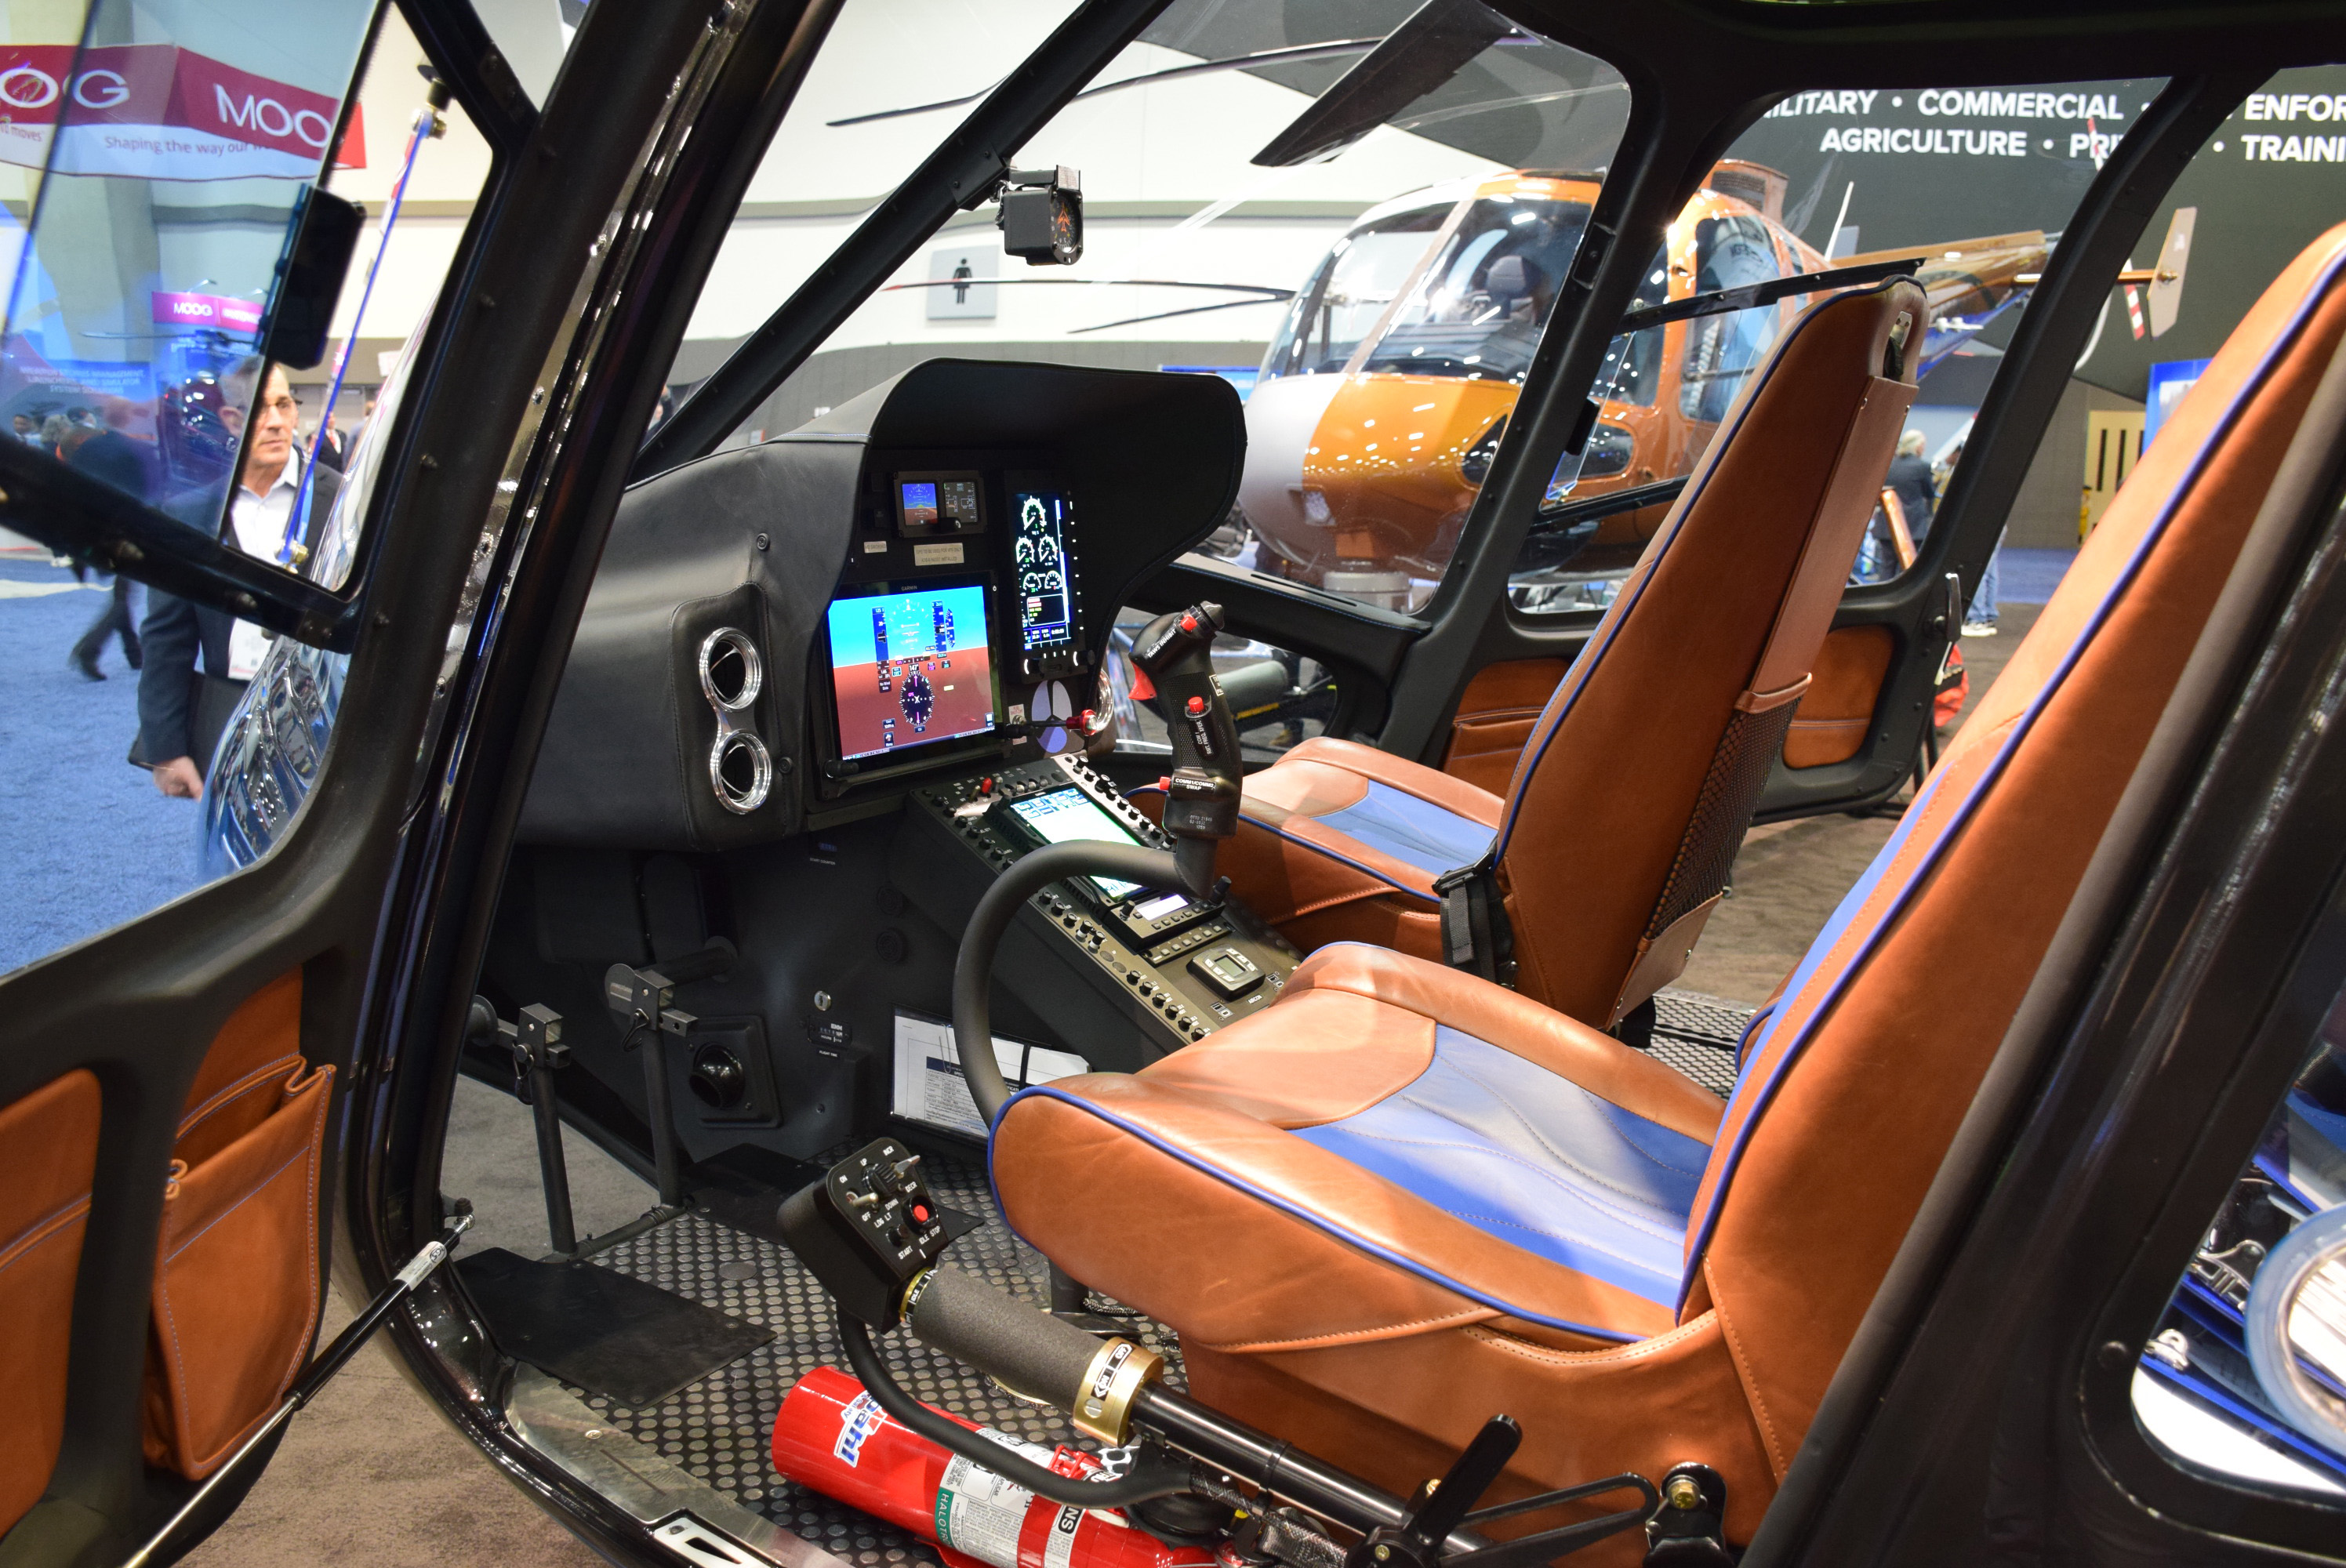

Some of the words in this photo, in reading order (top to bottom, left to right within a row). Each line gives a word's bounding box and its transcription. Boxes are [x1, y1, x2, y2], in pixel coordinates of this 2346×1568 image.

[0, 68, 129, 108] OG
[1917, 89, 2124, 119] COMMERCIAL
[2244, 94, 2346, 121] ENFOR
[213, 82, 332, 147] MOO
[104, 136, 162, 154] Shaping
[166, 139, 192, 153] the
[196, 143, 225, 157] way
[1819, 128, 2028, 157] AGRICULTURE
[2240, 134, 2346, 162] TRAINI
[173, 302, 213, 317] MOOG
[1147, 641, 1161, 658] TAWS
[1159, 629, 1177, 648] INHIBIT
[883, 1145, 894, 1156] INCR
[860, 1158, 867, 1167] UP
[839, 1174, 848, 1183] ON
[905, 1181, 917, 1193] DECR
[884, 1198, 899, 1211] DOWN
[862, 1211, 871, 1222] OFF
[873, 1217, 884, 1229] LDG
[884, 1212, 892, 1221] LT
[918, 1235, 930, 1245] IDLE
[929, 1225, 941, 1237] STOP
[898, 1245, 913, 1260] START
[910, 1289, 920, 1301] IDLE
[1099, 1374, 1109, 1389] ON
[936, 1493, 952, 1548] HALOTRO
[1061, 1508, 1079, 1530] NS
